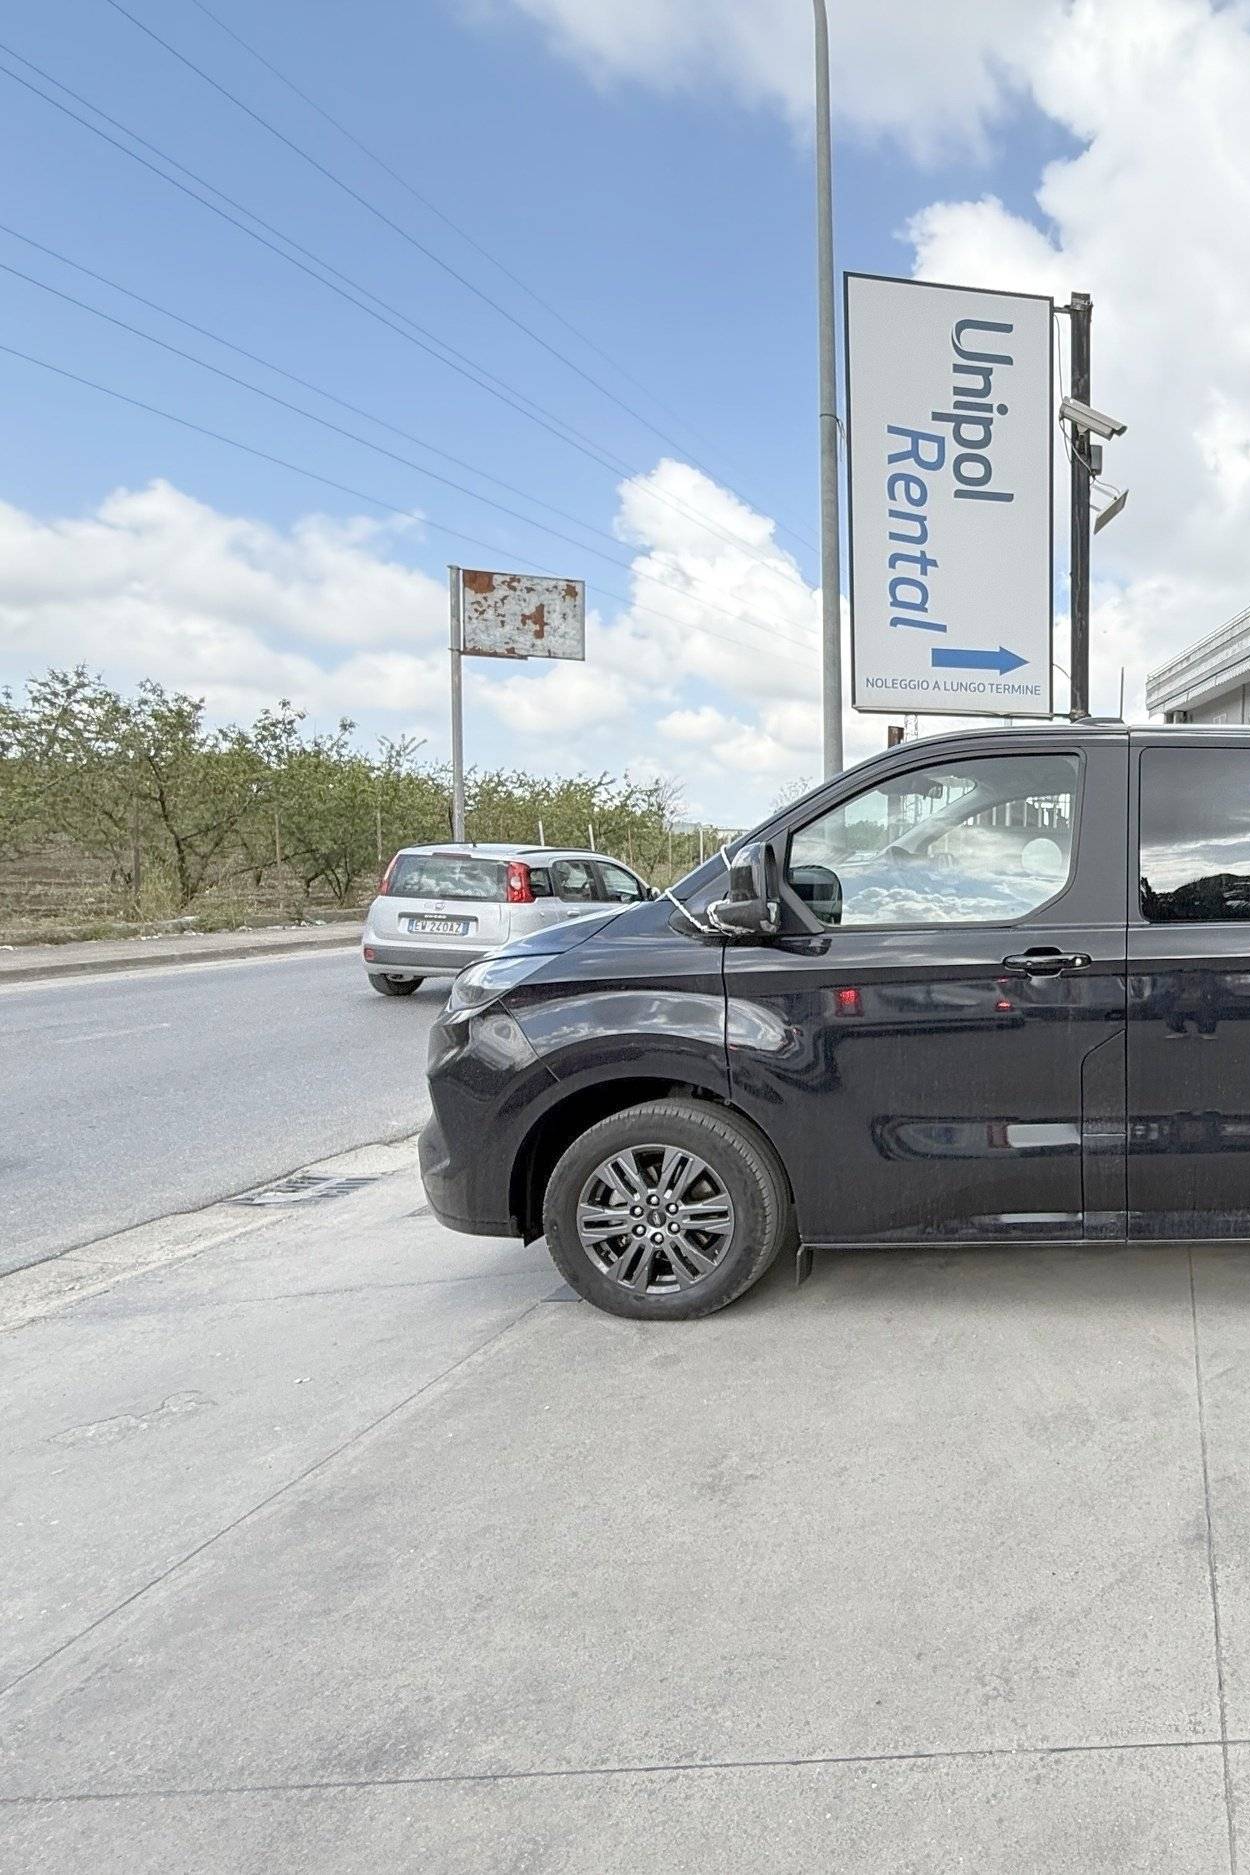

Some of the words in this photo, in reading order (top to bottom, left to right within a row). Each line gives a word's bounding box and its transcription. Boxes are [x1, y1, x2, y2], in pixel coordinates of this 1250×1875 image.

[931, 318, 1014, 503] Unipol
[886, 424, 948, 634] Rental
[865, 678, 930, 691] NOLEGGIO
[932, 681, 941, 692] A
[943, 681, 987, 694] LUNGO
[988, 683, 1041, 696] TERMINE
